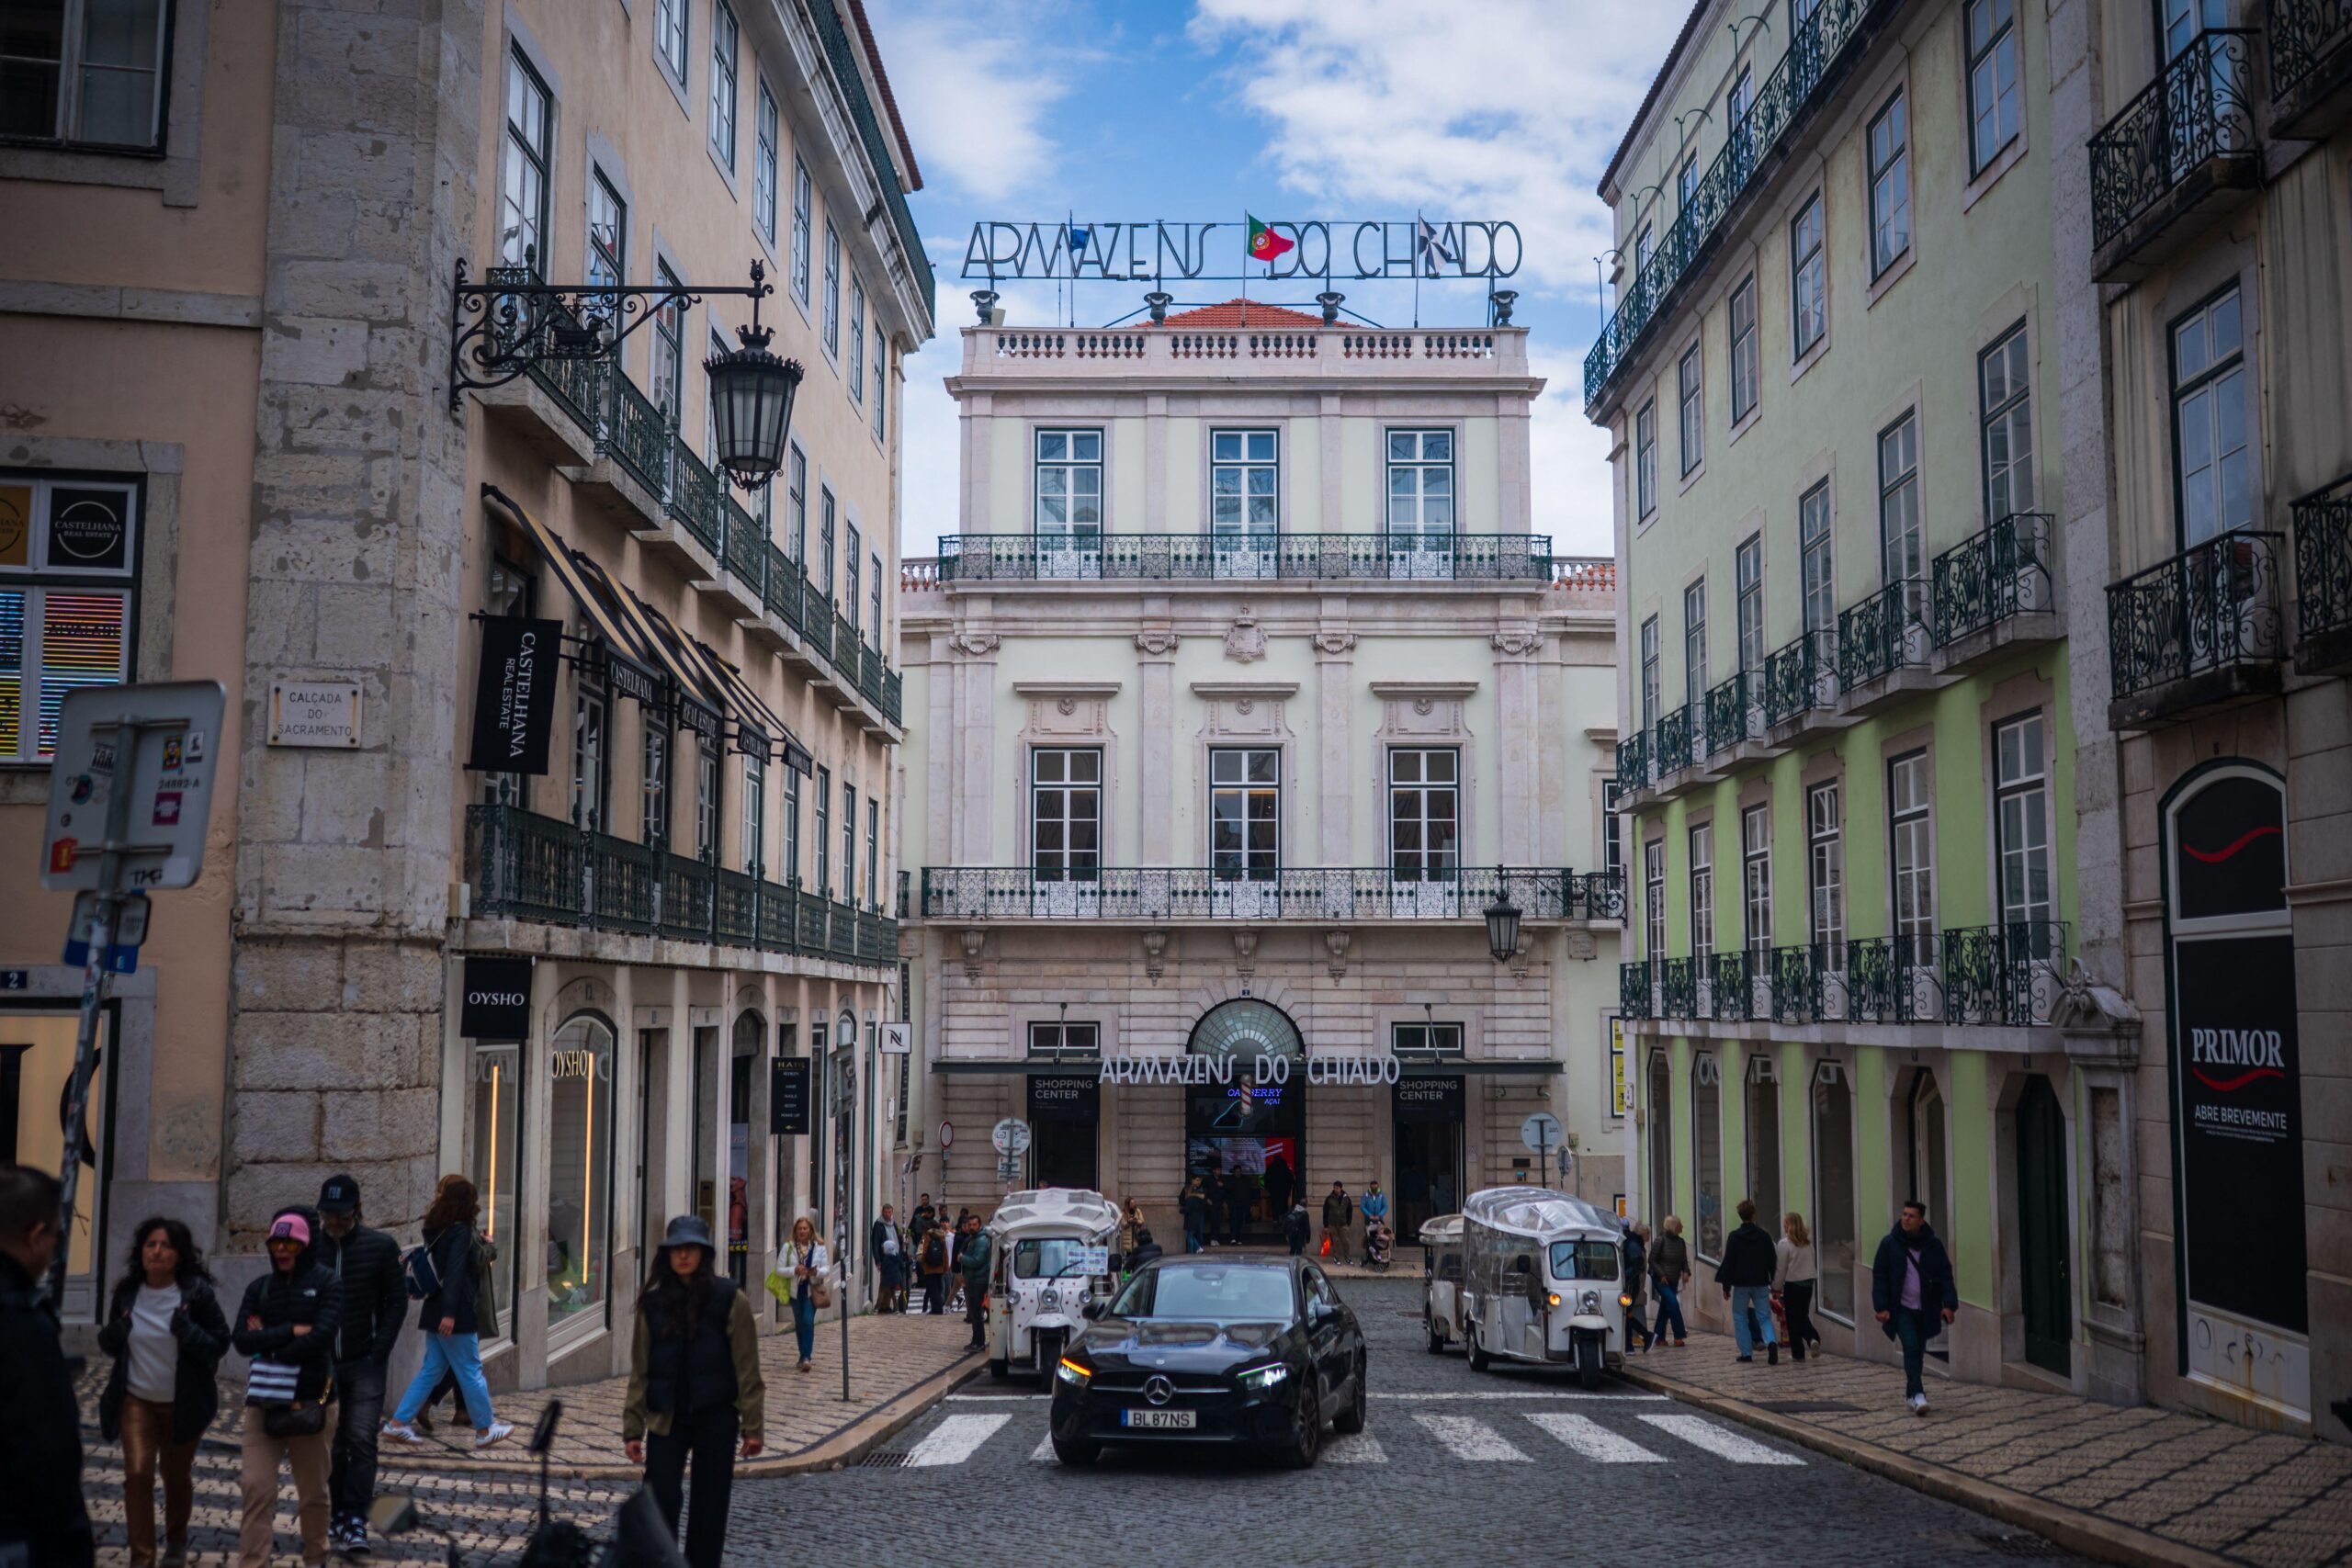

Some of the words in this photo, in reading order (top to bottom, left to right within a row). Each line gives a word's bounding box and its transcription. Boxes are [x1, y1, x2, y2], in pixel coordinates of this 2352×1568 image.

[961, 221, 1216, 278] ARMAZENS
[1270, 221, 1330, 277] DO
[55, 521, 121, 532] CASTELHANA
[503, 658, 515, 686] REAL
[610, 660, 652, 703] CASTELHANA
[499, 687, 512, 729] ESTATE
[510, 632, 536, 758] CASTELHANA
[308, 708, 322, 719] DO
[278, 724, 352, 737] SACRAMENTO
[469, 991, 526, 1007] OYSHO
[2191, 1028, 2286, 1068] PRIMOR
[551, 1049, 588, 1078] OYSHO
[1098, 1054, 1238, 1084] ARMAZENS
[1255, 1055, 1289, 1084] DO
[1307, 1054, 1400, 1085] CHIADO
[1035, 1079, 1093, 1089] SHOPPING
[1035, 1089, 1079, 1100] CENTER
[1399, 1080, 1457, 1090] SHOPPING
[1399, 1090, 1443, 1100] CENTER
[2194, 1104, 2219, 1122] ABRE
[2221, 1107, 2288, 1131] BREVEMENTE
